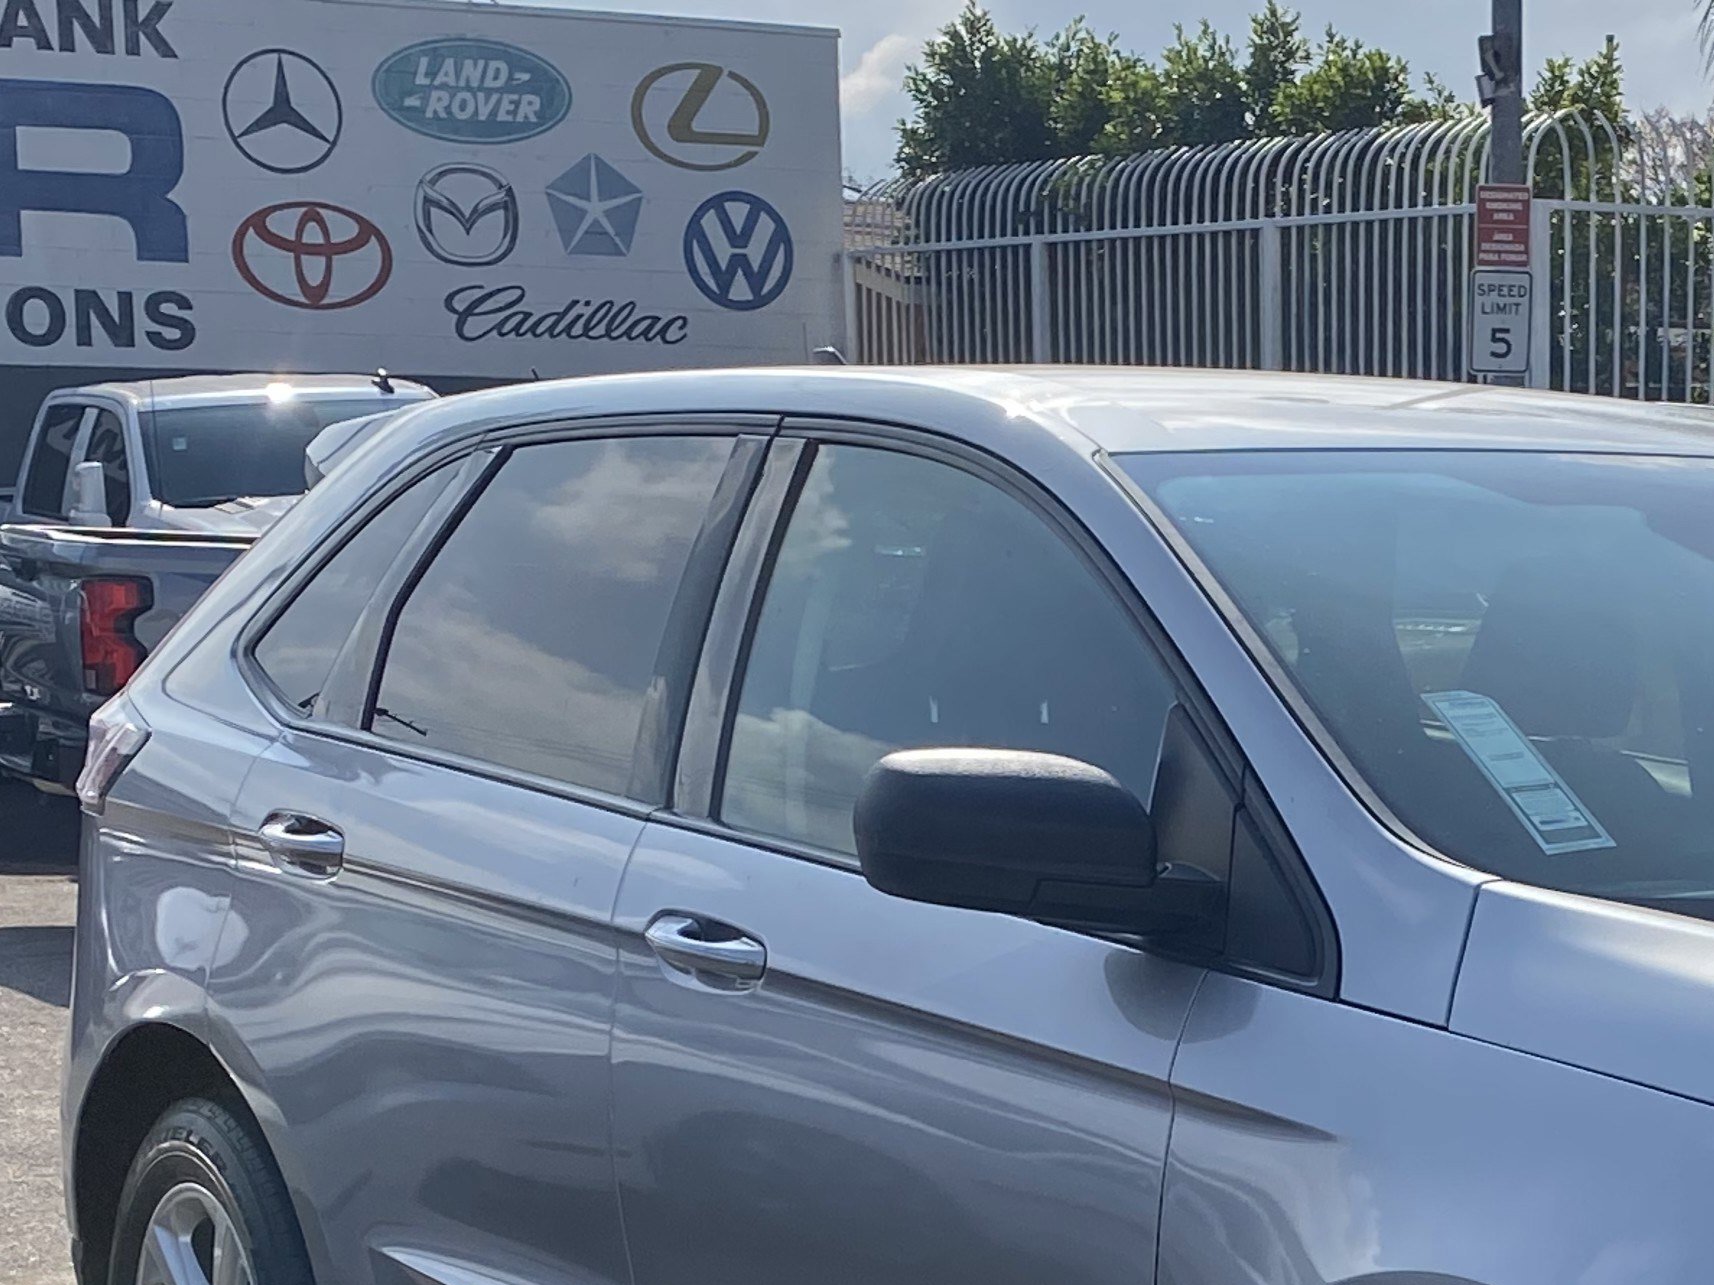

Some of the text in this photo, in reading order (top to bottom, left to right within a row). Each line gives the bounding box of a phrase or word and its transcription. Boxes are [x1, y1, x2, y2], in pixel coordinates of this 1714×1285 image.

[414, 57, 510, 88] LAND
[424, 89, 542, 123] ROVER
[1476, 283, 1528, 298] SPEED
[5, 285, 197, 351] ONS
[444, 283, 689, 346] Cadillac
[1480, 302, 1522, 316] LIMIT
[1489, 327, 1513, 359] 5
